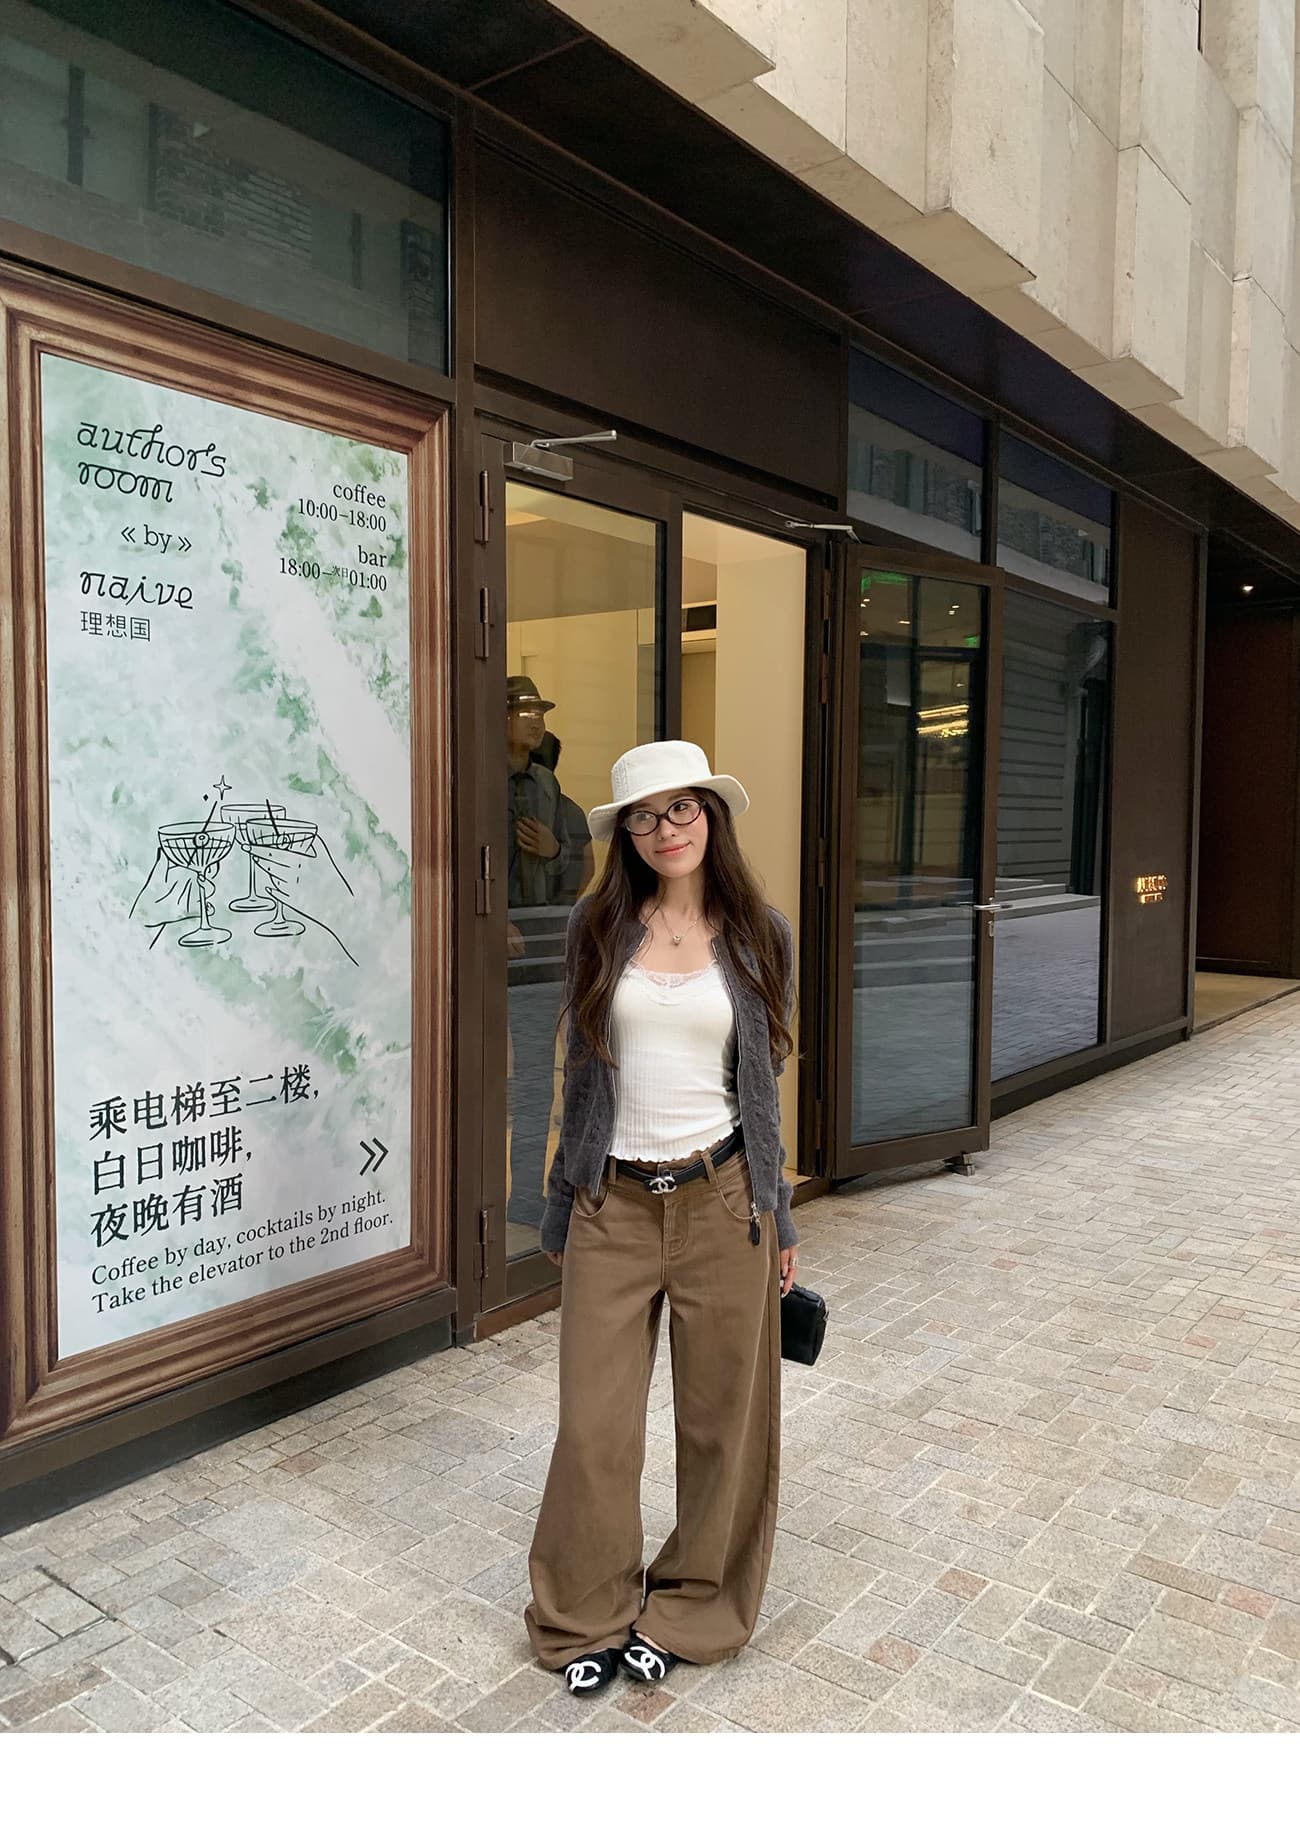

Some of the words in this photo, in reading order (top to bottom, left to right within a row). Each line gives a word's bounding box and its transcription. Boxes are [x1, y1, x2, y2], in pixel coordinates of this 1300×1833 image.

[76, 421, 227, 478] author's
[77, 461, 174, 503] room
[332, 483, 387, 509] coffee
[143, 523, 173, 555] by
[357, 544, 388, 569] bar
[79, 570, 194, 610] naive
[79, 611, 152, 643] 理想国
[88, 1063, 320, 1142] 乘电梯至二楼，
[93, 1125, 252, 1196] 白日咖啡，
[89, 1173, 244, 1249] 夜晚有酒
[91, 1255, 159, 1286] Coffee
[165, 1246, 188, 1267] by
[193, 1234, 232, 1259] day,
[236, 1211, 313, 1246] cocktails
[317, 1202, 337, 1224] by
[341, 1190, 387, 1217] night.
[91, 1284, 147, 1314] Take
[151, 1274, 184, 1298] the
[188, 1251, 264, 1286] elevator
[268, 1245, 286, 1262] to
[289, 1233, 316, 1256] the
[319, 1225, 350, 1246] 2nd
[353, 1212, 394, 1235] floor.
